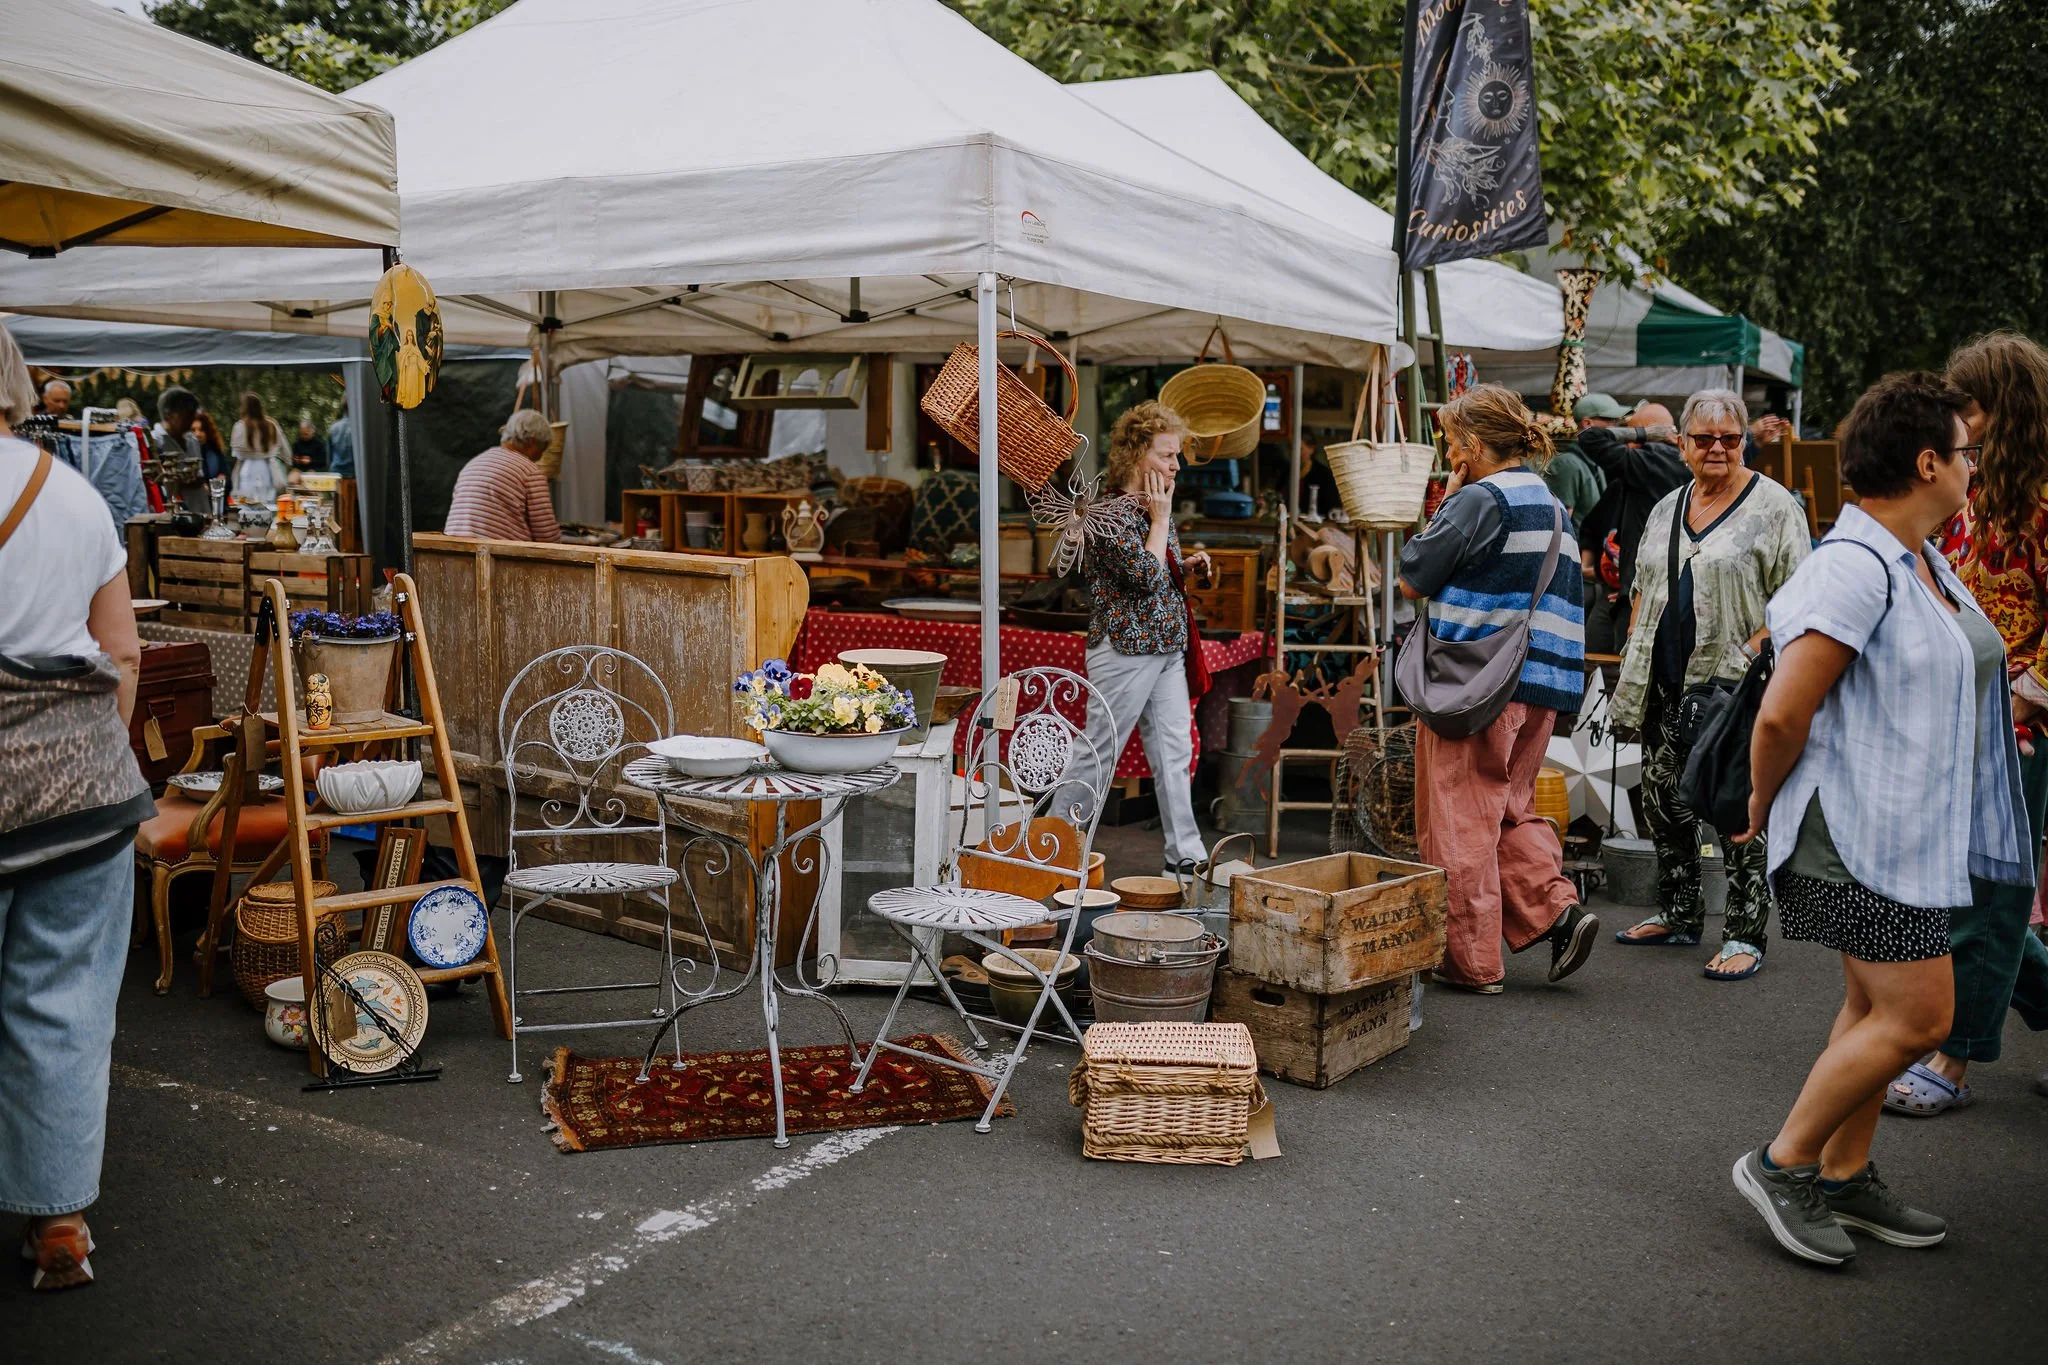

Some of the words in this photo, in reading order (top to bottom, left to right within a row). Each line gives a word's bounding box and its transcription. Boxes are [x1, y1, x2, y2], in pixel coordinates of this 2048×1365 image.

[1407, 189, 1527, 242] Curiosities
[1351, 902, 1427, 931] WATNEY
[1362, 928, 1416, 955] MANN
[1346, 1011, 1388, 1041] MANN
